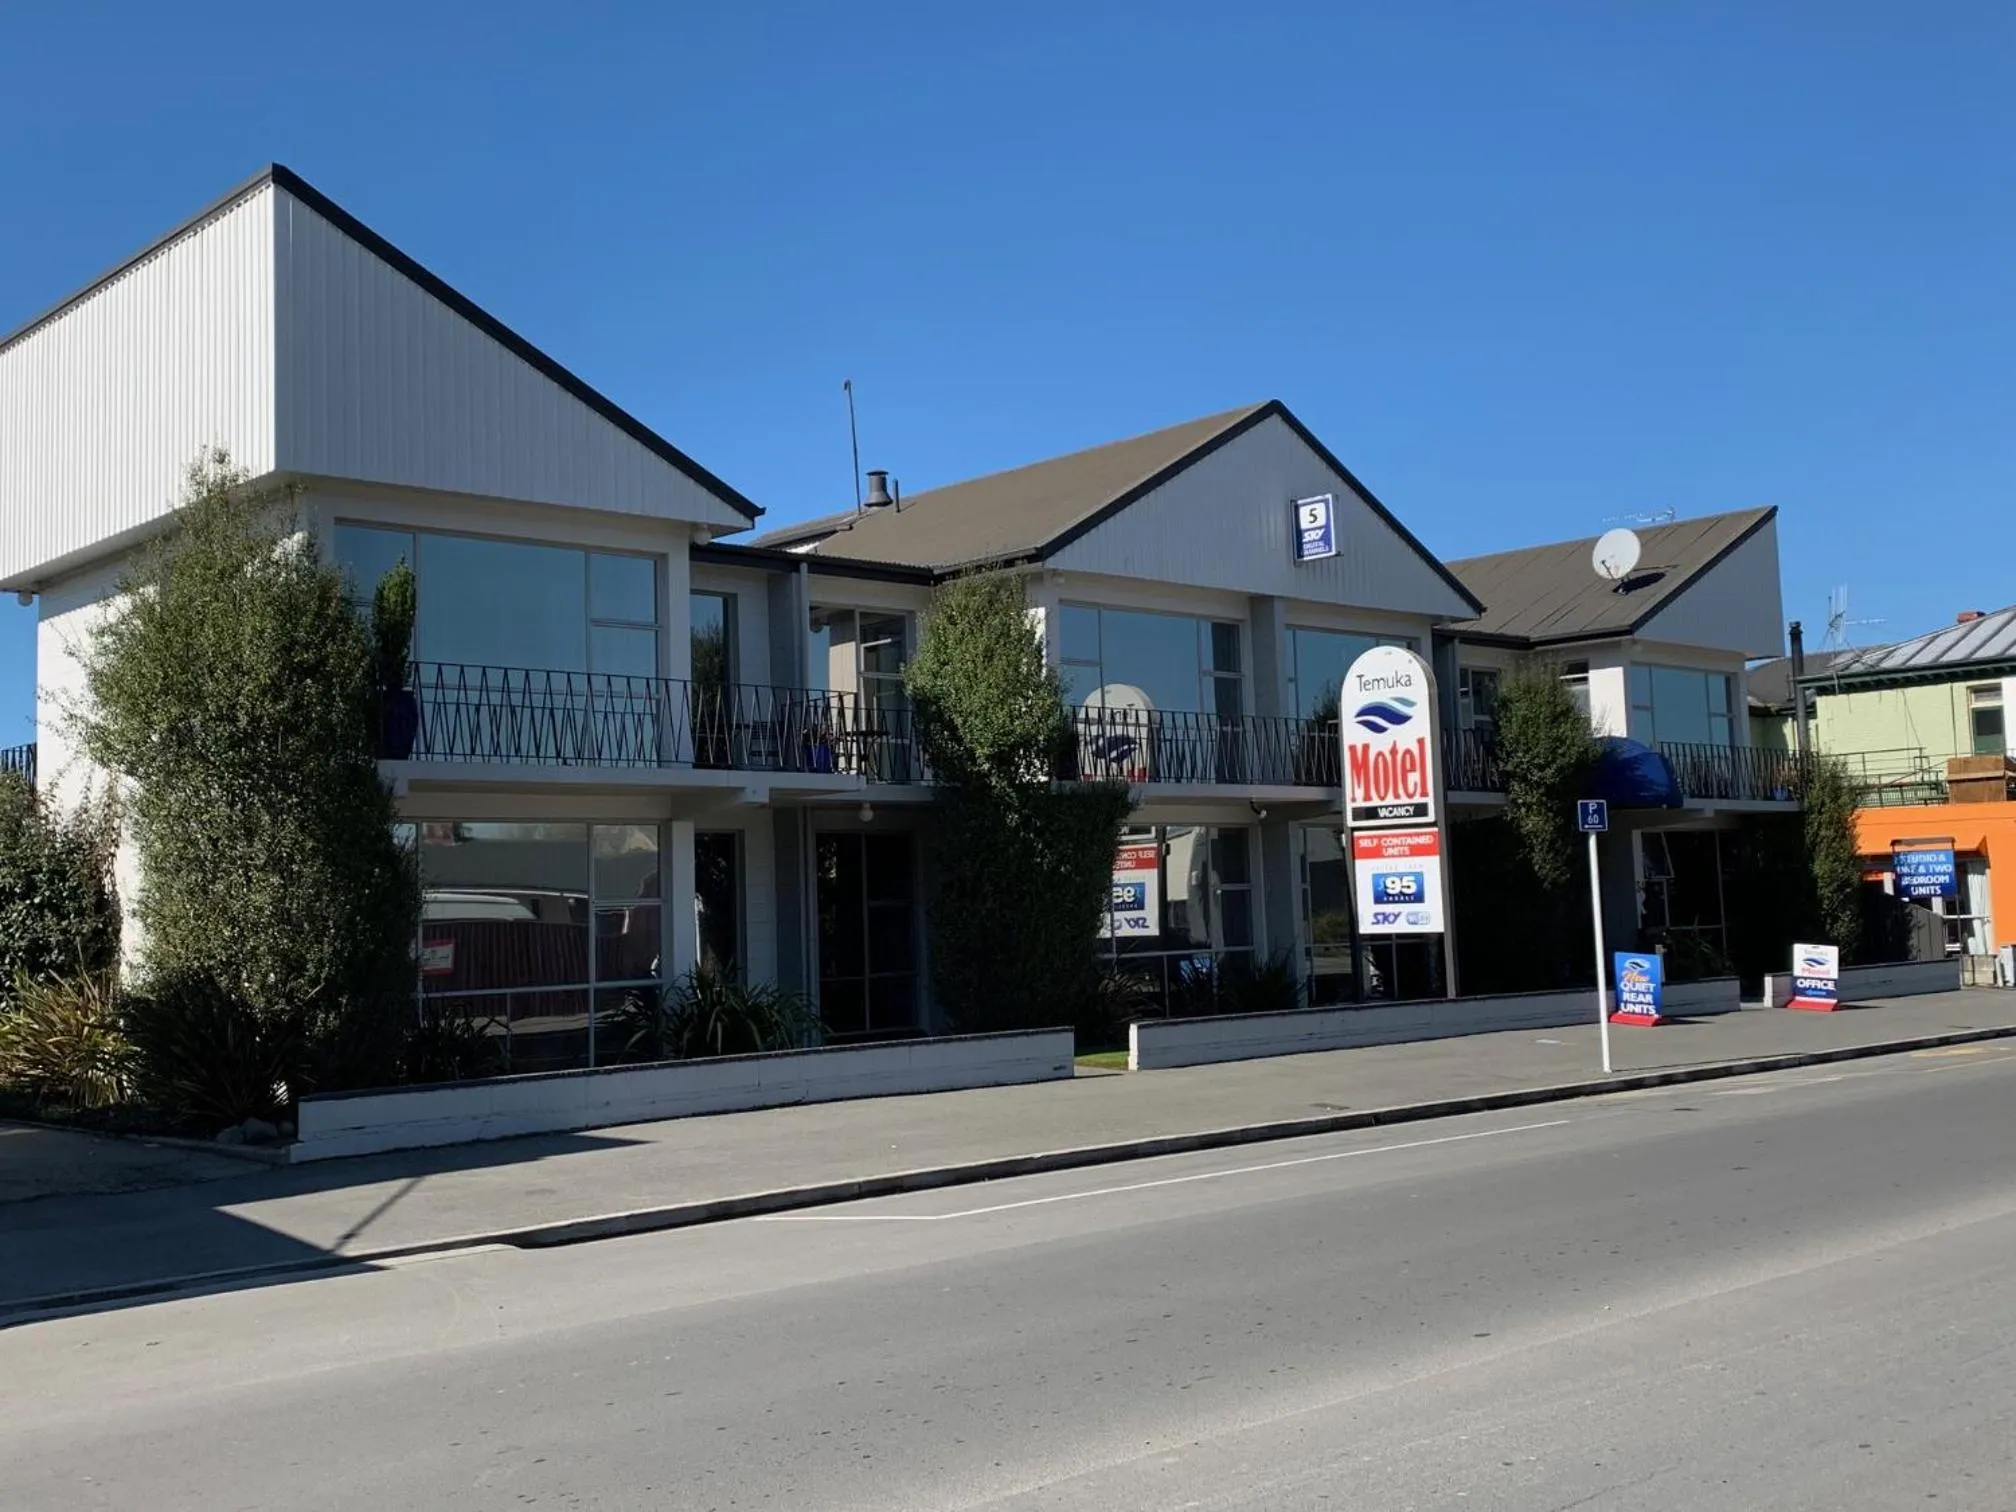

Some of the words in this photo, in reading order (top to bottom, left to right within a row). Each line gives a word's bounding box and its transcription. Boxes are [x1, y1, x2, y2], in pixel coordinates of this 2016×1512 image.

[1308, 507, 1318, 524] 5
[1356, 670, 1413, 693] Temuka
[1348, 736, 1429, 803] Motel
[1377, 806, 1415, 818] VACANCY
[1589, 803, 1598, 814] P
[1587, 814, 1599, 824] 60
[1359, 838, 1378, 848] SELF
[1380, 835, 1434, 846] CONTAINED
[1382, 846, 1410, 857] UNITS
[1901, 854, 1937, 863] STUDIO
[1930, 864, 1952, 873] TWO
[1902, 874, 1950, 885] BEDROOM
[1911, 886, 1941, 895] UNITS
[1371, 911, 1402, 926] SKY
[1620, 981, 1656, 992] QUIET
[1797, 979, 1836, 990] OFFICE
[1623, 992, 1653, 1004] REAR
[1620, 1003, 1656, 1014] UNITS
